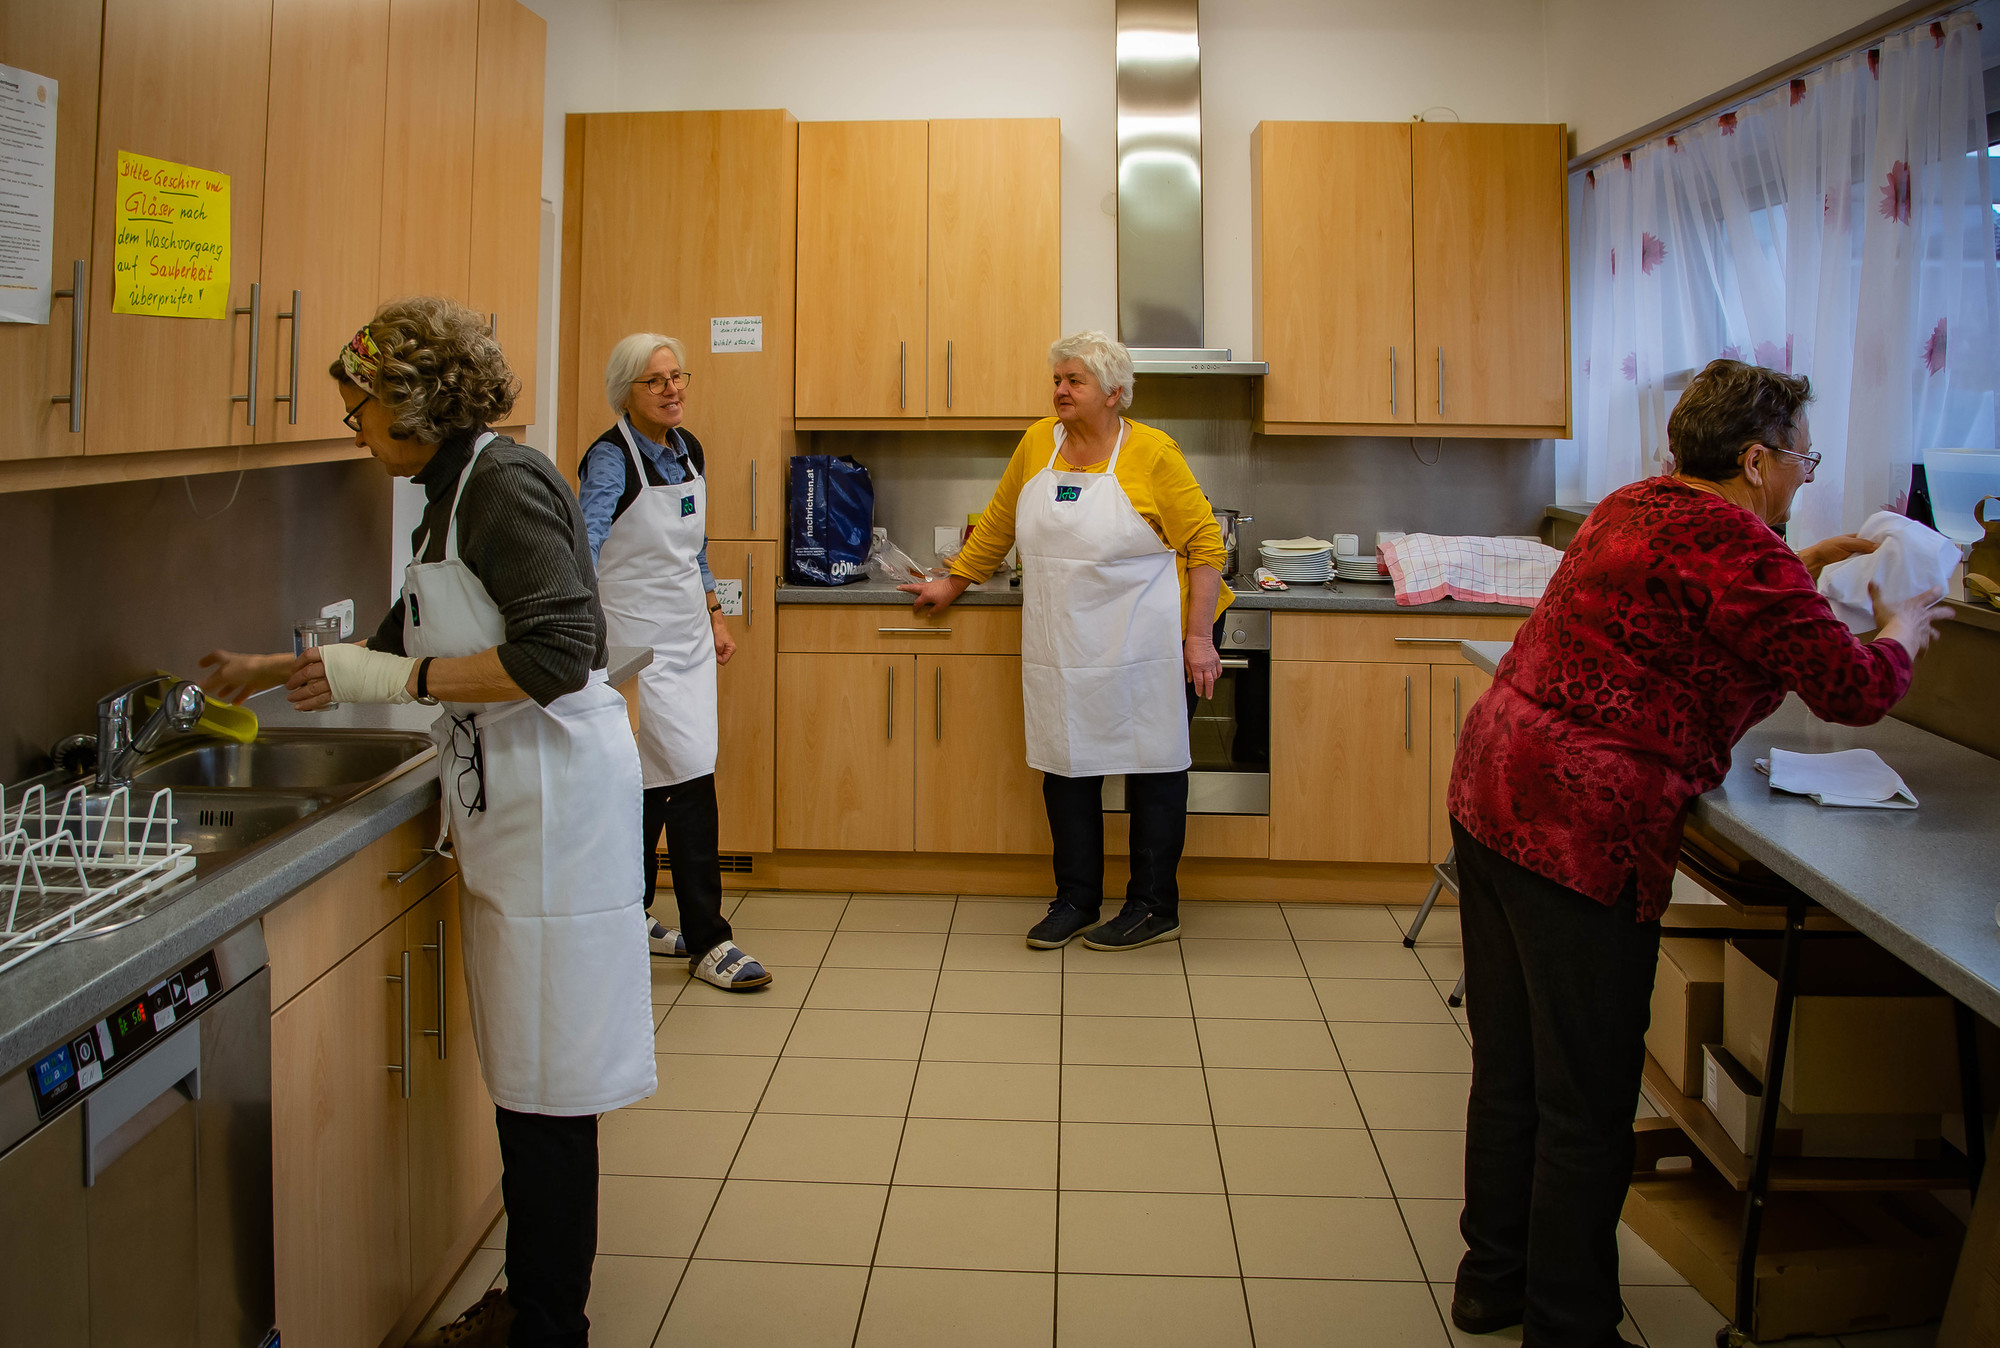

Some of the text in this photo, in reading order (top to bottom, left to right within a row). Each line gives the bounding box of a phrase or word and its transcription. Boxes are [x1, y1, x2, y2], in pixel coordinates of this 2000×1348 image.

[121, 160, 152, 182] Bitte
[153, 169, 200, 190] Geschirr
[125, 191, 208, 220] Gläser nach
[117, 226, 223, 262] dem Waschvorgang
[117, 254, 213, 281] auf Sauberkeit
[805, 468, 814, 537] nachrichten.at
